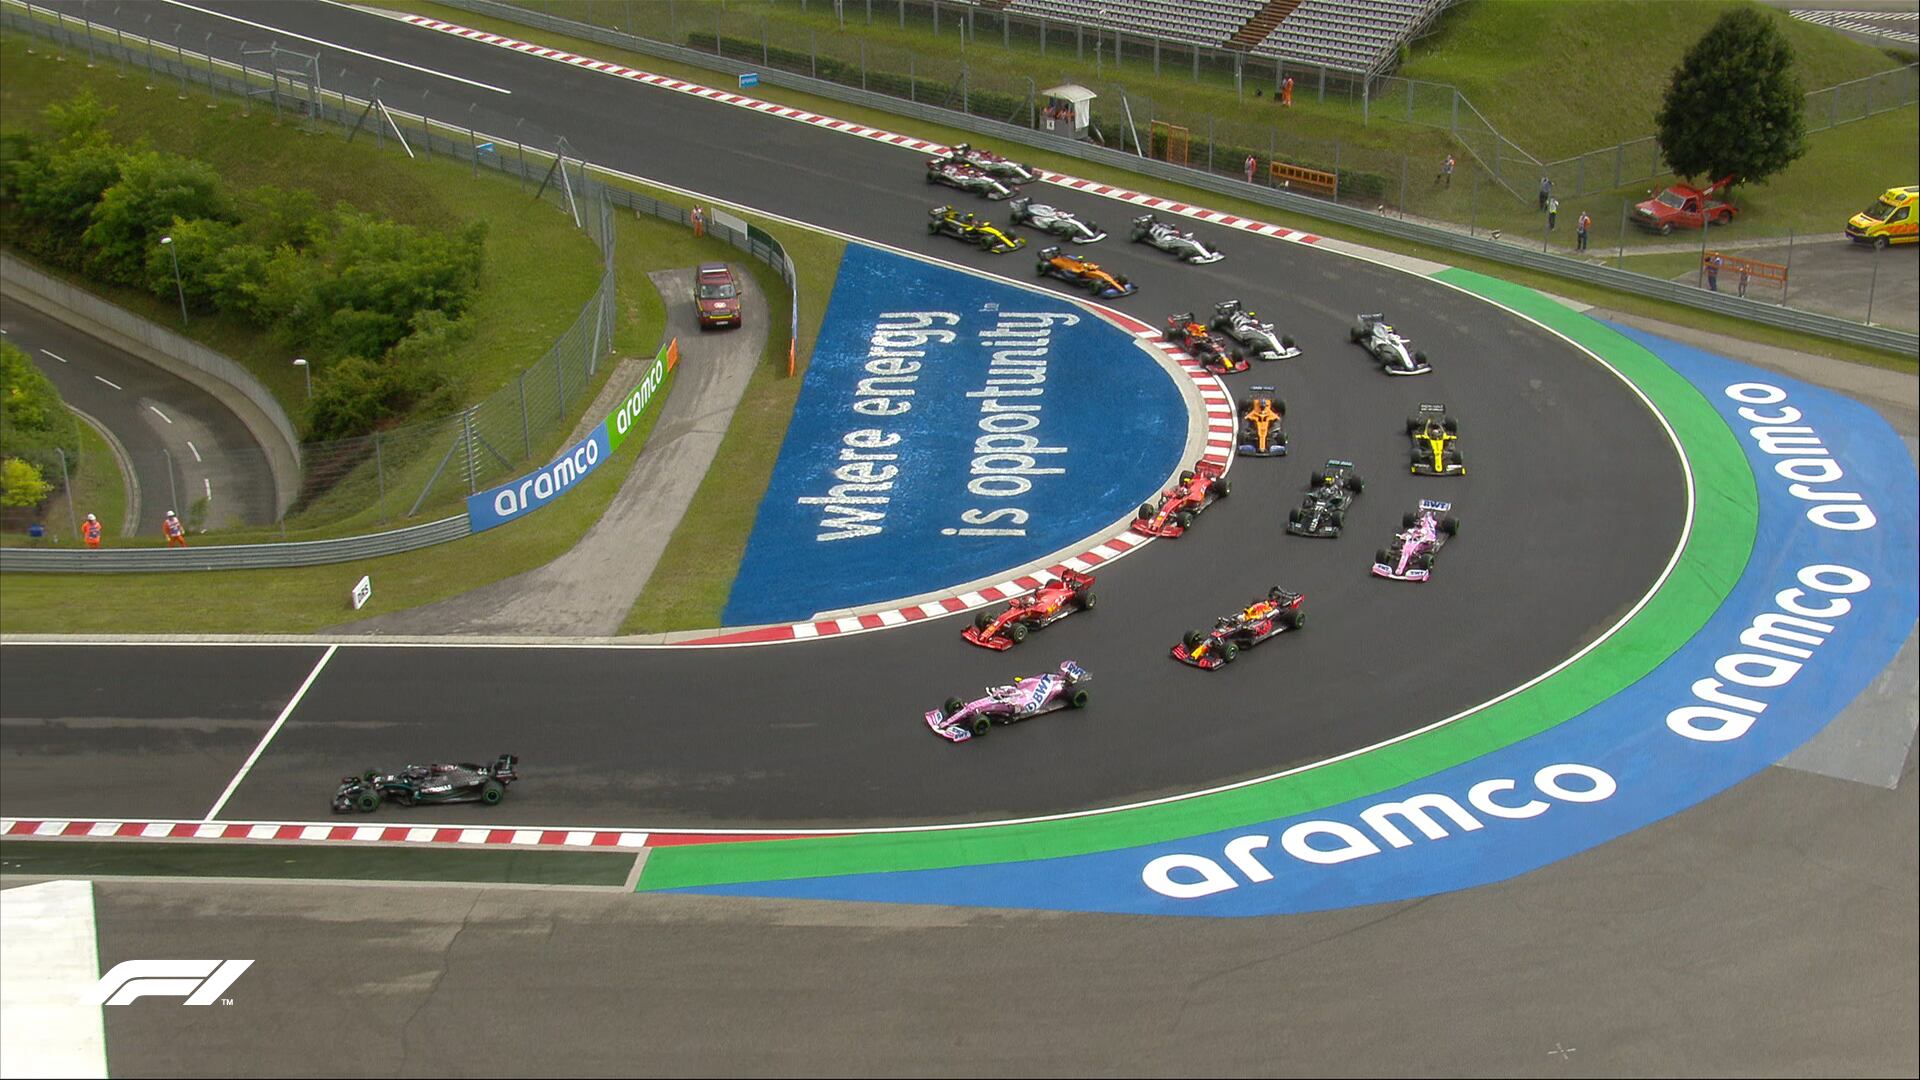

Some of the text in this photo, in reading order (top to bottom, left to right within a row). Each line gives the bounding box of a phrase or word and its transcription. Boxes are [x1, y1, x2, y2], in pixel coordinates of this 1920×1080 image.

[616, 360, 663, 435] aramco
[798, 311, 961, 541] where energy
[966, 312, 1080, 496] opportunity
[1724, 382, 1877, 531] aramco
[494, 438, 599, 517] aramco
[941, 507, 1030, 537] is
[1034, 673, 1051, 704] BWT
[1665, 564, 1871, 742] aramco
[1141, 763, 1617, 899] aramco
